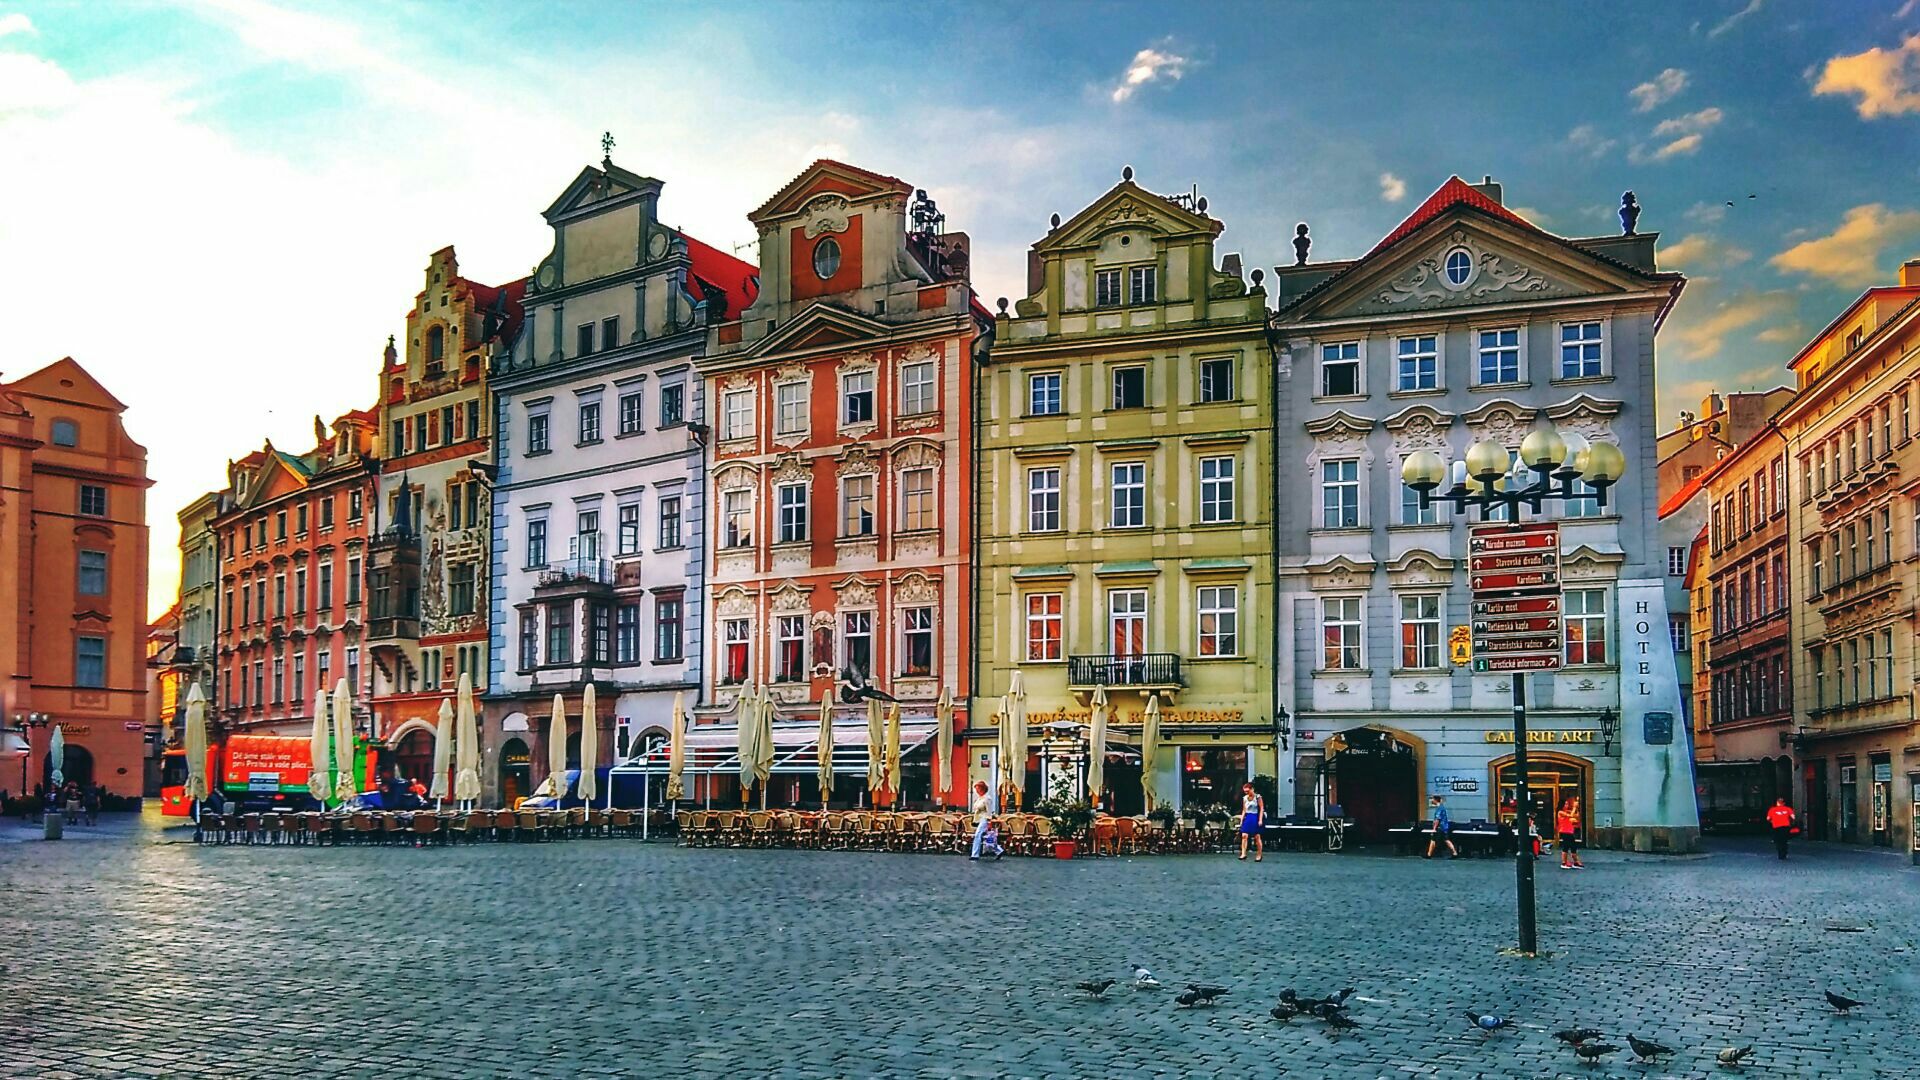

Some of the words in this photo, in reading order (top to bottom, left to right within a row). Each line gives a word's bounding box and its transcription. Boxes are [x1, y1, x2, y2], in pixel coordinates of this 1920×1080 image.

[1505, 540, 1526, 548] muzeum
[1505, 603, 1518, 611] most
[1515, 621, 1529, 631] kaple
[1524, 640, 1543, 649] radnice
[1636, 601, 1651, 696] HOTEL
[1489, 659, 1516, 669] Turistické
[1516, 658, 1546, 668] informace
[1559, 730, 1595, 743] ART
